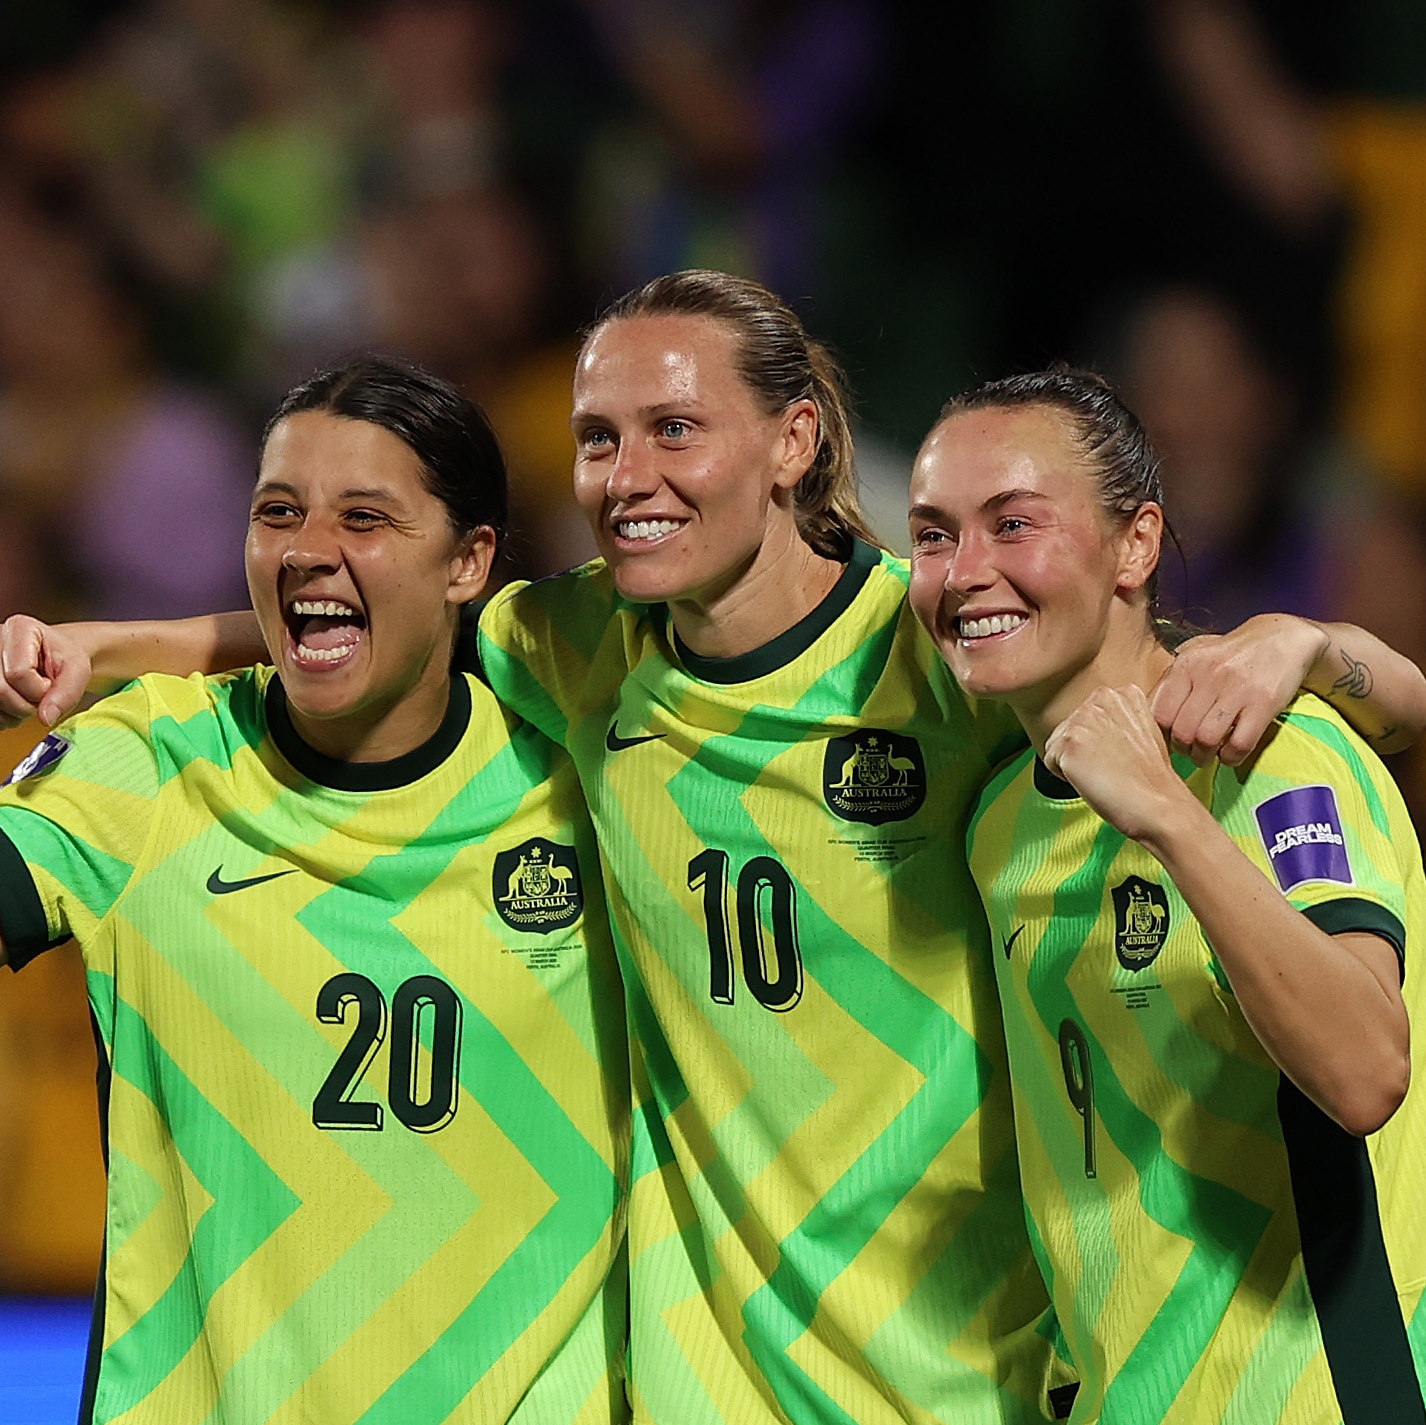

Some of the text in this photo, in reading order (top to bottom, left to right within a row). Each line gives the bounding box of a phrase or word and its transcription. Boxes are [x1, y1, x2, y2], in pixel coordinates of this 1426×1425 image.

[841, 787, 907, 798] AUSTRALIA
[1274, 822, 1332, 844] DREAM
[1269, 832, 1343, 860] FEARLESS
[510, 896, 569, 910] AUSTRALIA
[687, 848, 804, 1013] 10
[1124, 935, 1159, 945] AUSTRALIA
[312, 972, 464, 1134] 20
[1058, 1017, 1097, 1179] 9
